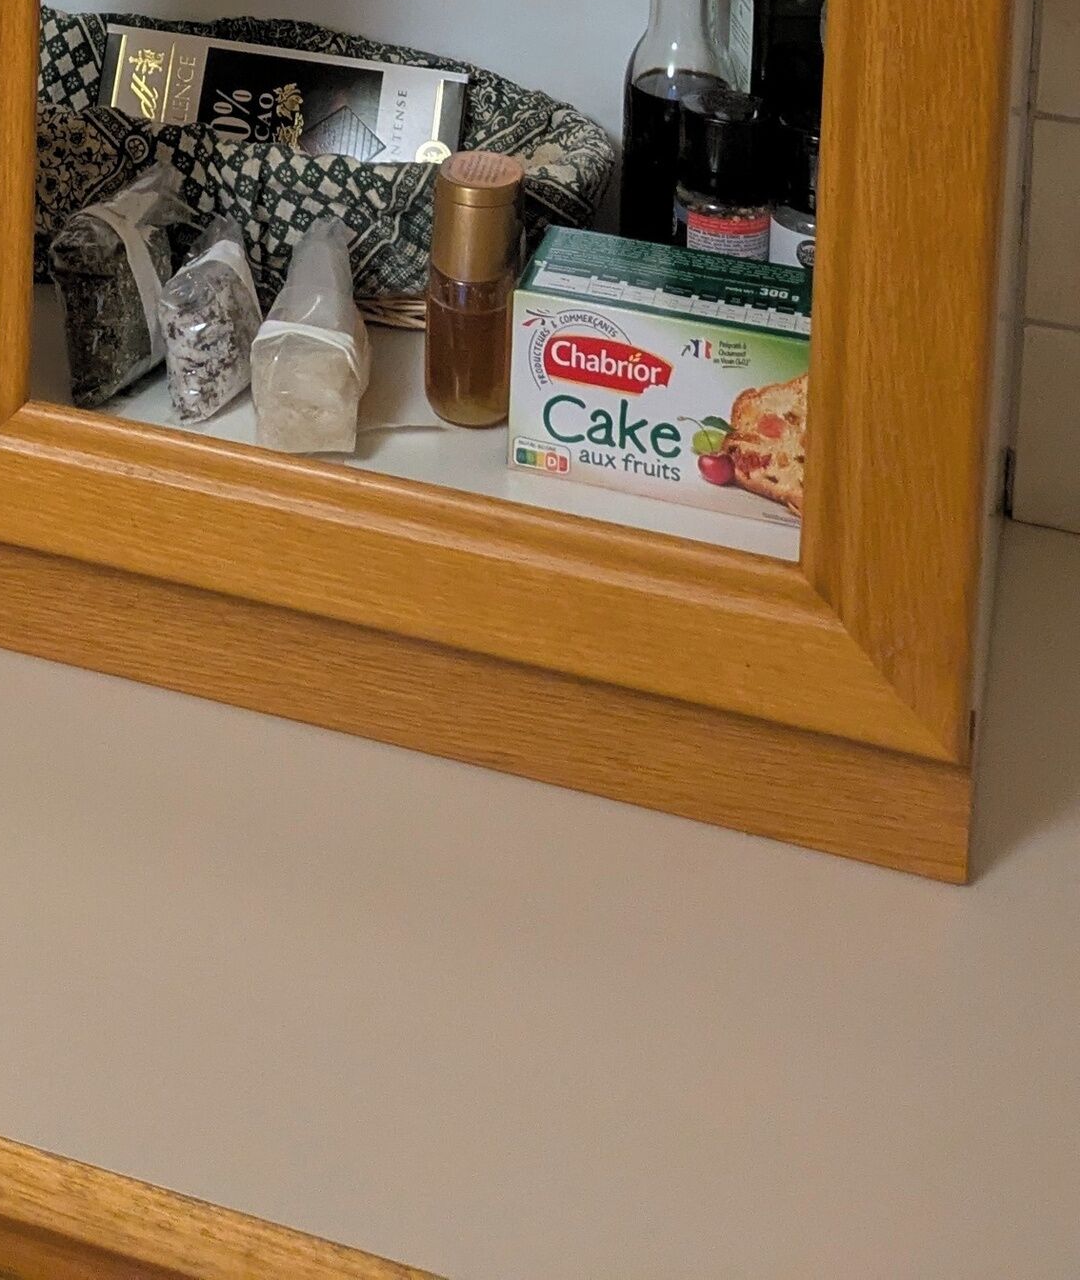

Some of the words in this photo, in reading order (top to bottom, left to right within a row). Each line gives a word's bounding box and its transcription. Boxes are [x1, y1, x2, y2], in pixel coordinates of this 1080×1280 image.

[172, 56, 196, 122] LENCE
[210, 89, 253, 141] 0%
[254, 93, 275, 141] CAO
[390, 90, 408, 157] NTENSE
[759, 287, 789, 299] 300
[531, 328, 550, 385] PRODUCTEURS
[559, 313, 619, 338] COMMERÇANTS
[550, 340, 662, 383] Chabrior
[543, 394, 682, 458] Cake
[547, 456, 556, 466] D
[578, 449, 617, 470] aux
[622, 452, 681, 482] fruits
